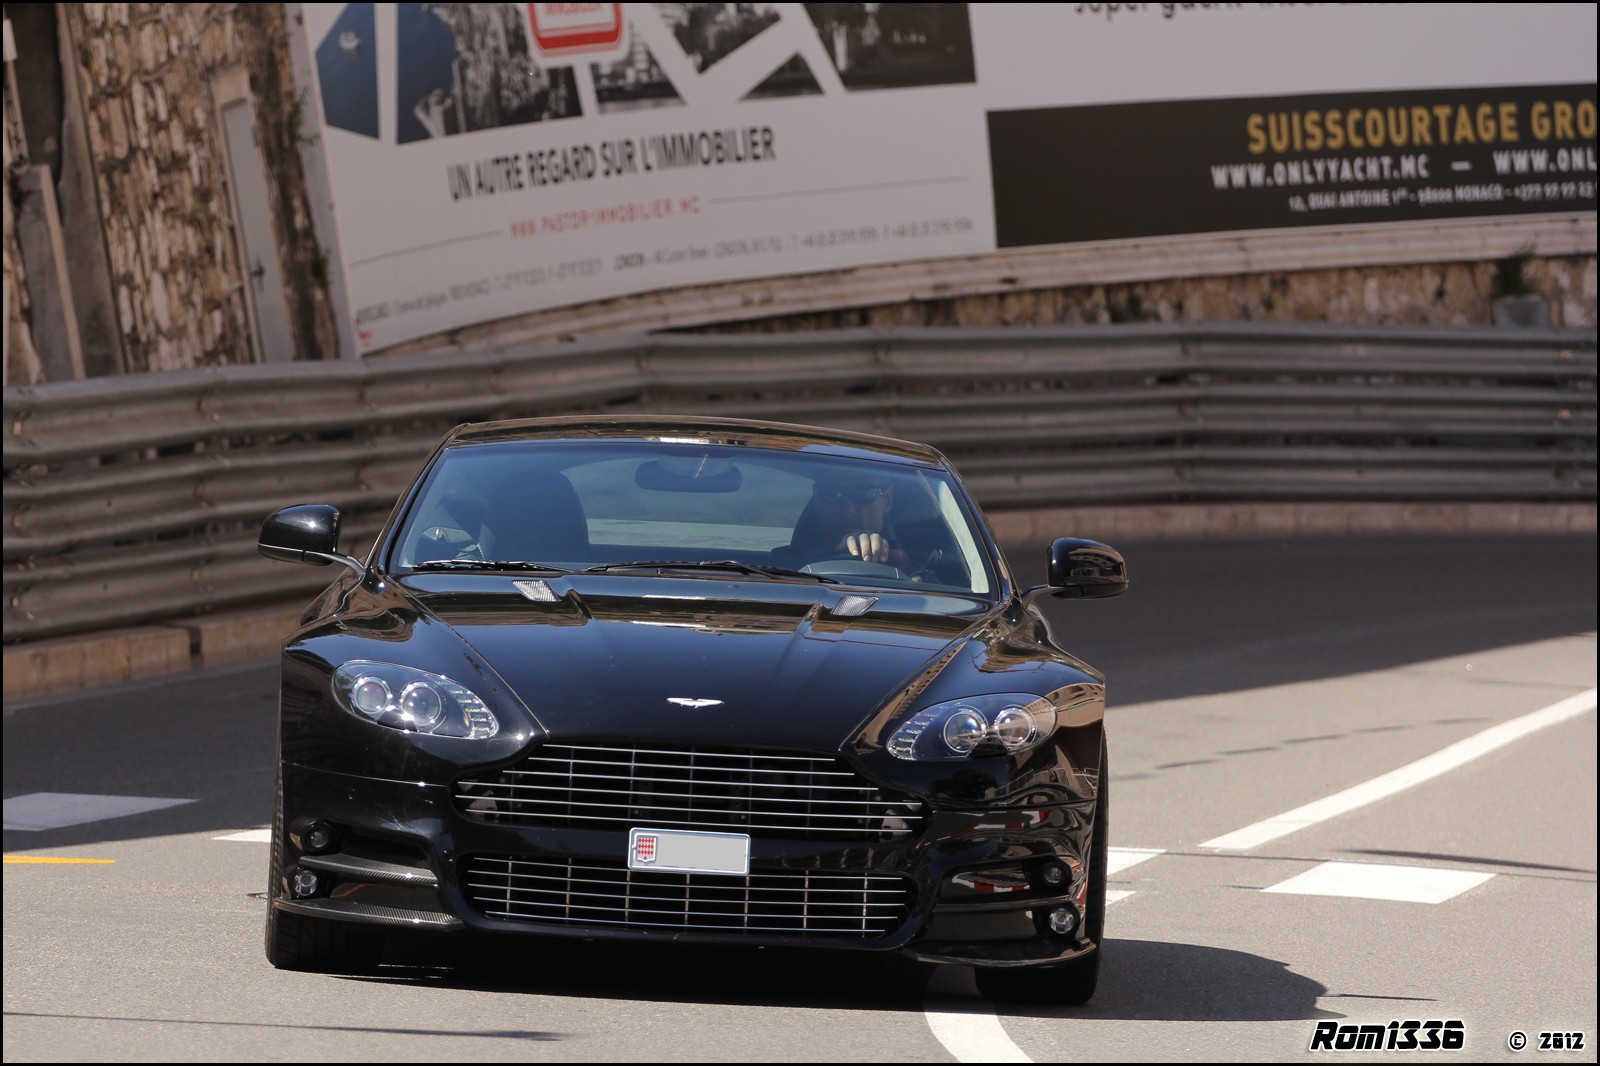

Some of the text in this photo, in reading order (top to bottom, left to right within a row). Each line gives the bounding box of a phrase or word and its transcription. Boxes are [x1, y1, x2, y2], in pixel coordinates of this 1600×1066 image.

[1247, 99, 1596, 154] SUISSCOURTAGE GRO
[449, 126, 776, 200] UN AUTRE REGARD SUR L'IMMOBILIER
[1211, 152, 1430, 190] WWW.ONLYYACHT.MC
[1339, 188, 1391, 207] ANTOINE
[1454, 183, 1504, 202] MONACO
